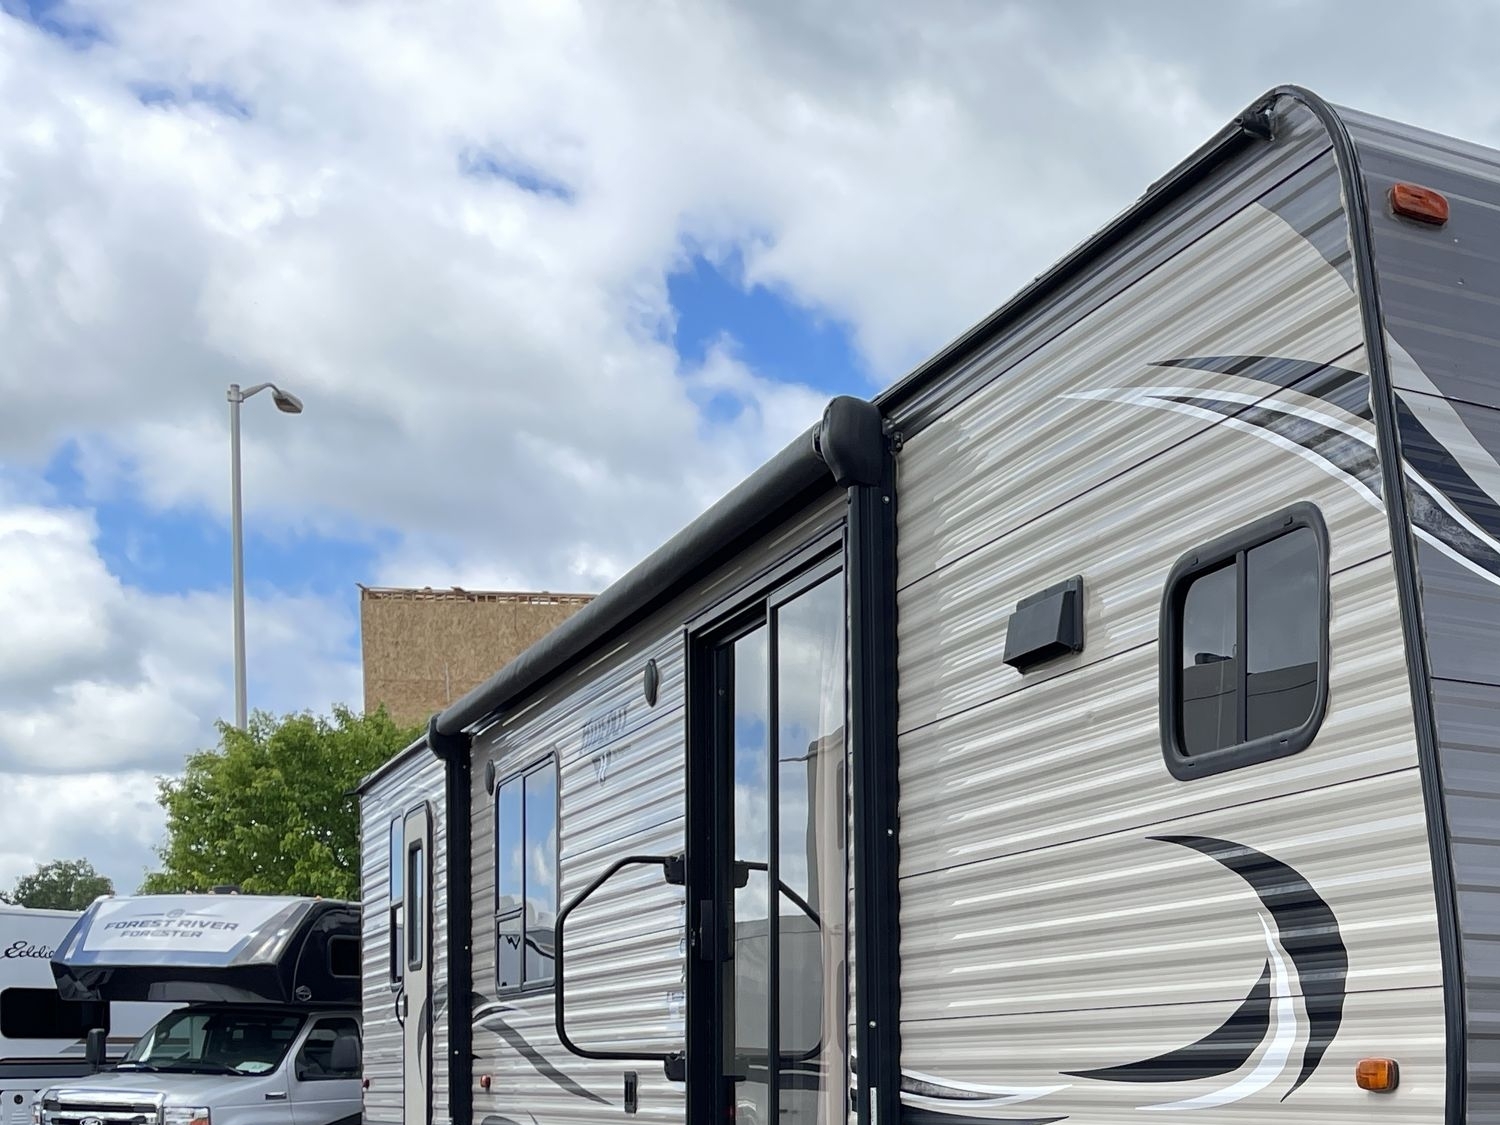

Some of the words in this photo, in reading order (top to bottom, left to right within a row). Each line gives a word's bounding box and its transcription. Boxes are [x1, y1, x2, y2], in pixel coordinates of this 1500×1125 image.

[104, 919, 177, 931] FOREST
[178, 919, 240, 931] RIVER
[120, 929, 204, 938] FORESTER
